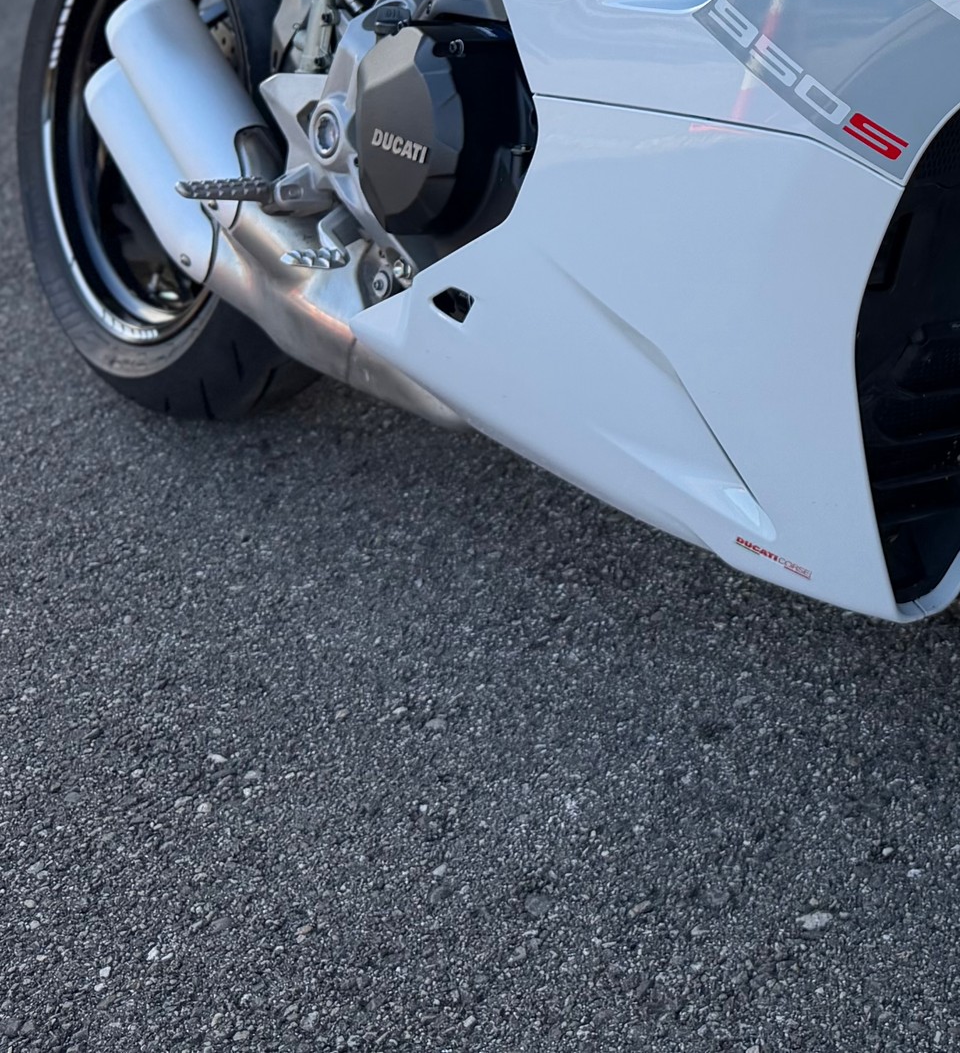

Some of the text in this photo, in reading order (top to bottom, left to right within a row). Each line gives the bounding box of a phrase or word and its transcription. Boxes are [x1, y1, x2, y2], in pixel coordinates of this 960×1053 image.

[371, 128, 428, 164] DUCATI
[736, 536, 811, 576] DUCATI CORSE
